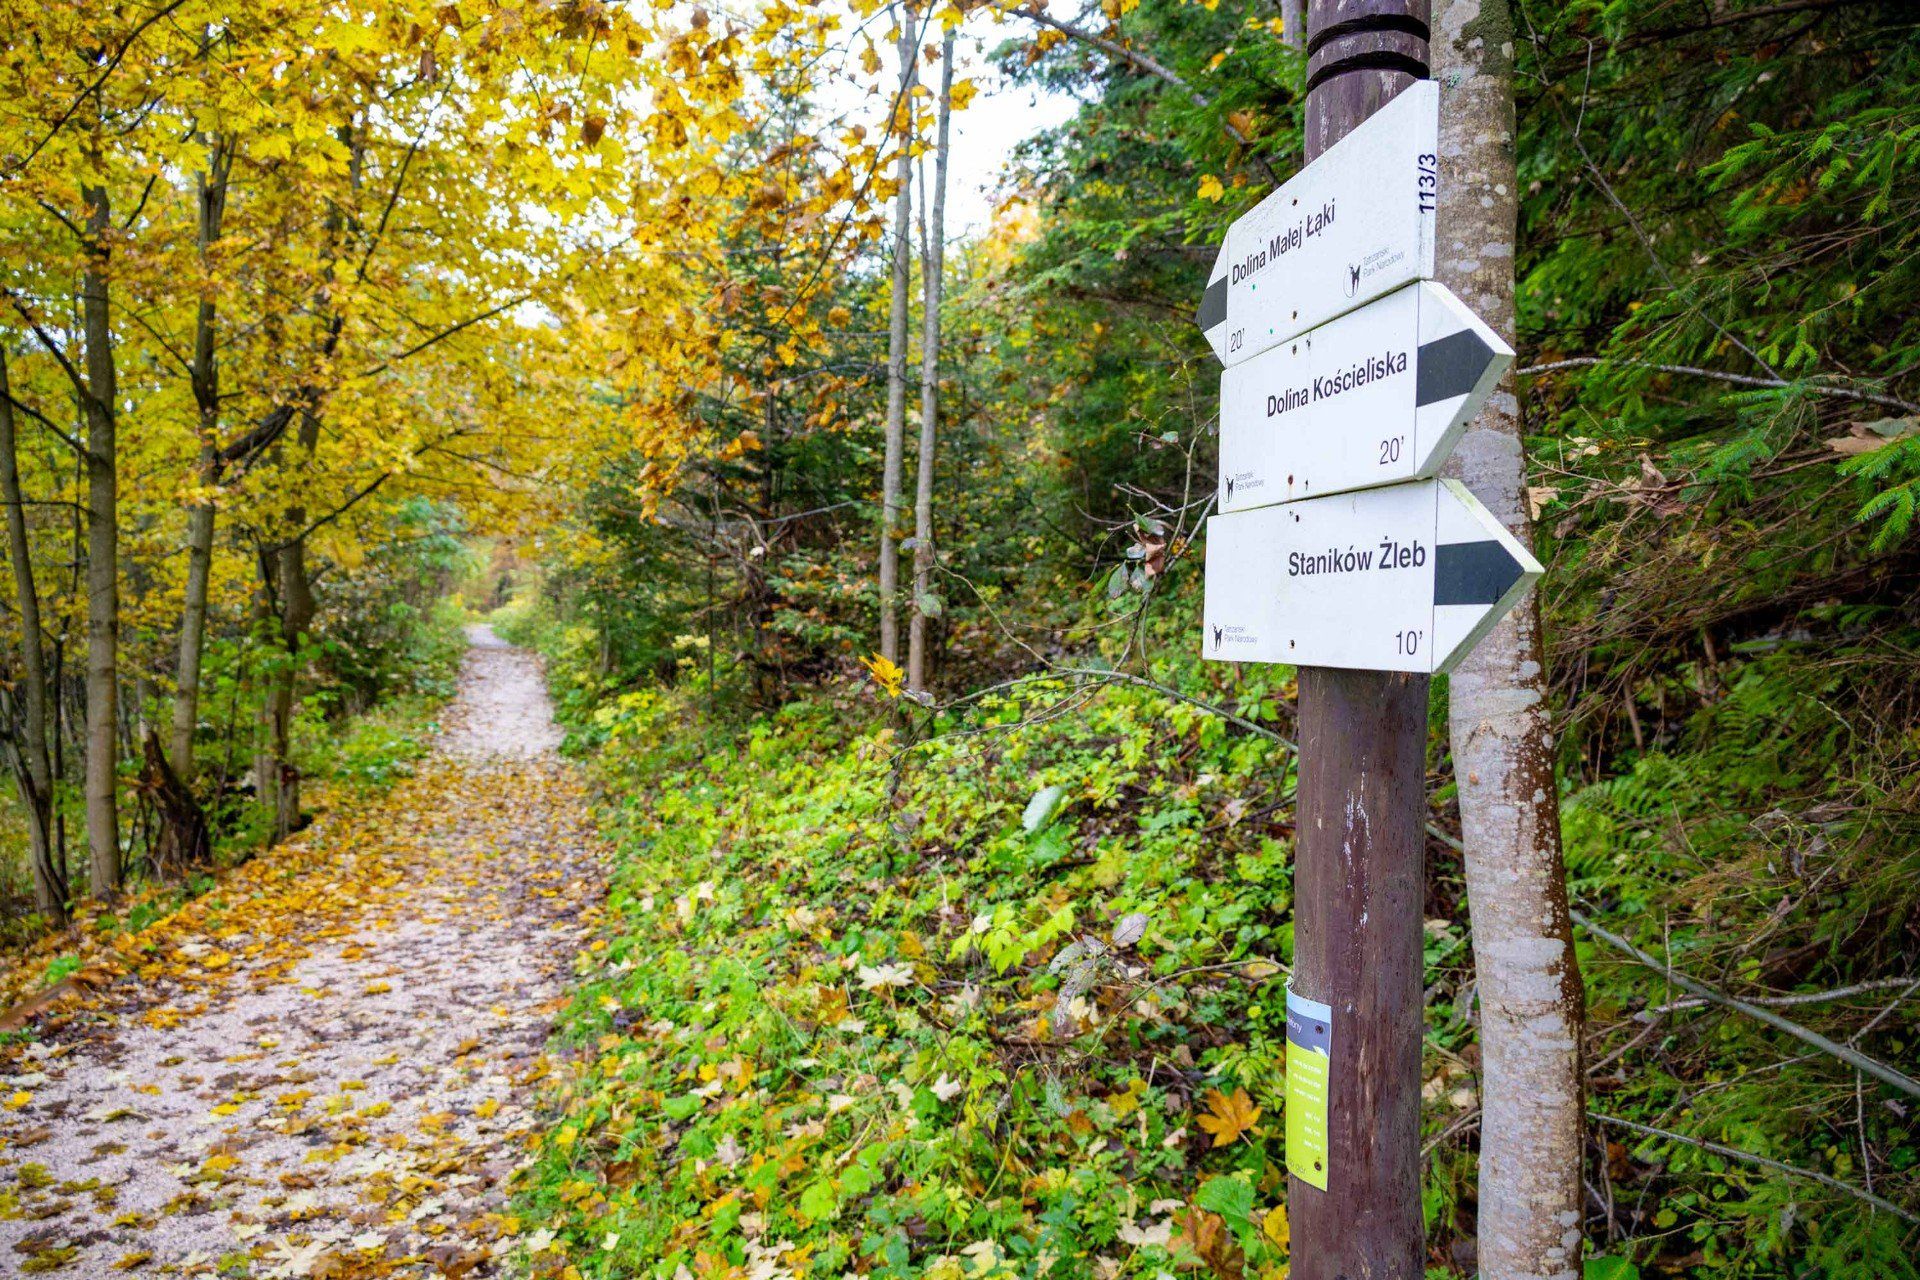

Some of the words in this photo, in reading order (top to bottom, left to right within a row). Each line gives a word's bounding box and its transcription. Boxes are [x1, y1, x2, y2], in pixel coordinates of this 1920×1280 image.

[1418, 153, 1437, 215] 113/3
[1232, 250, 1266, 286] Dolina
[1269, 220, 1303, 262] Małej
[1306, 197, 1336, 238] Łąki
[1230, 327, 1245, 353] 20'
[1267, 388, 1309, 418] Dolina
[1313, 350, 1407, 402] Kościeliska
[1288, 544, 1373, 577] Staników
[1378, 535, 1426, 570] Żleb
